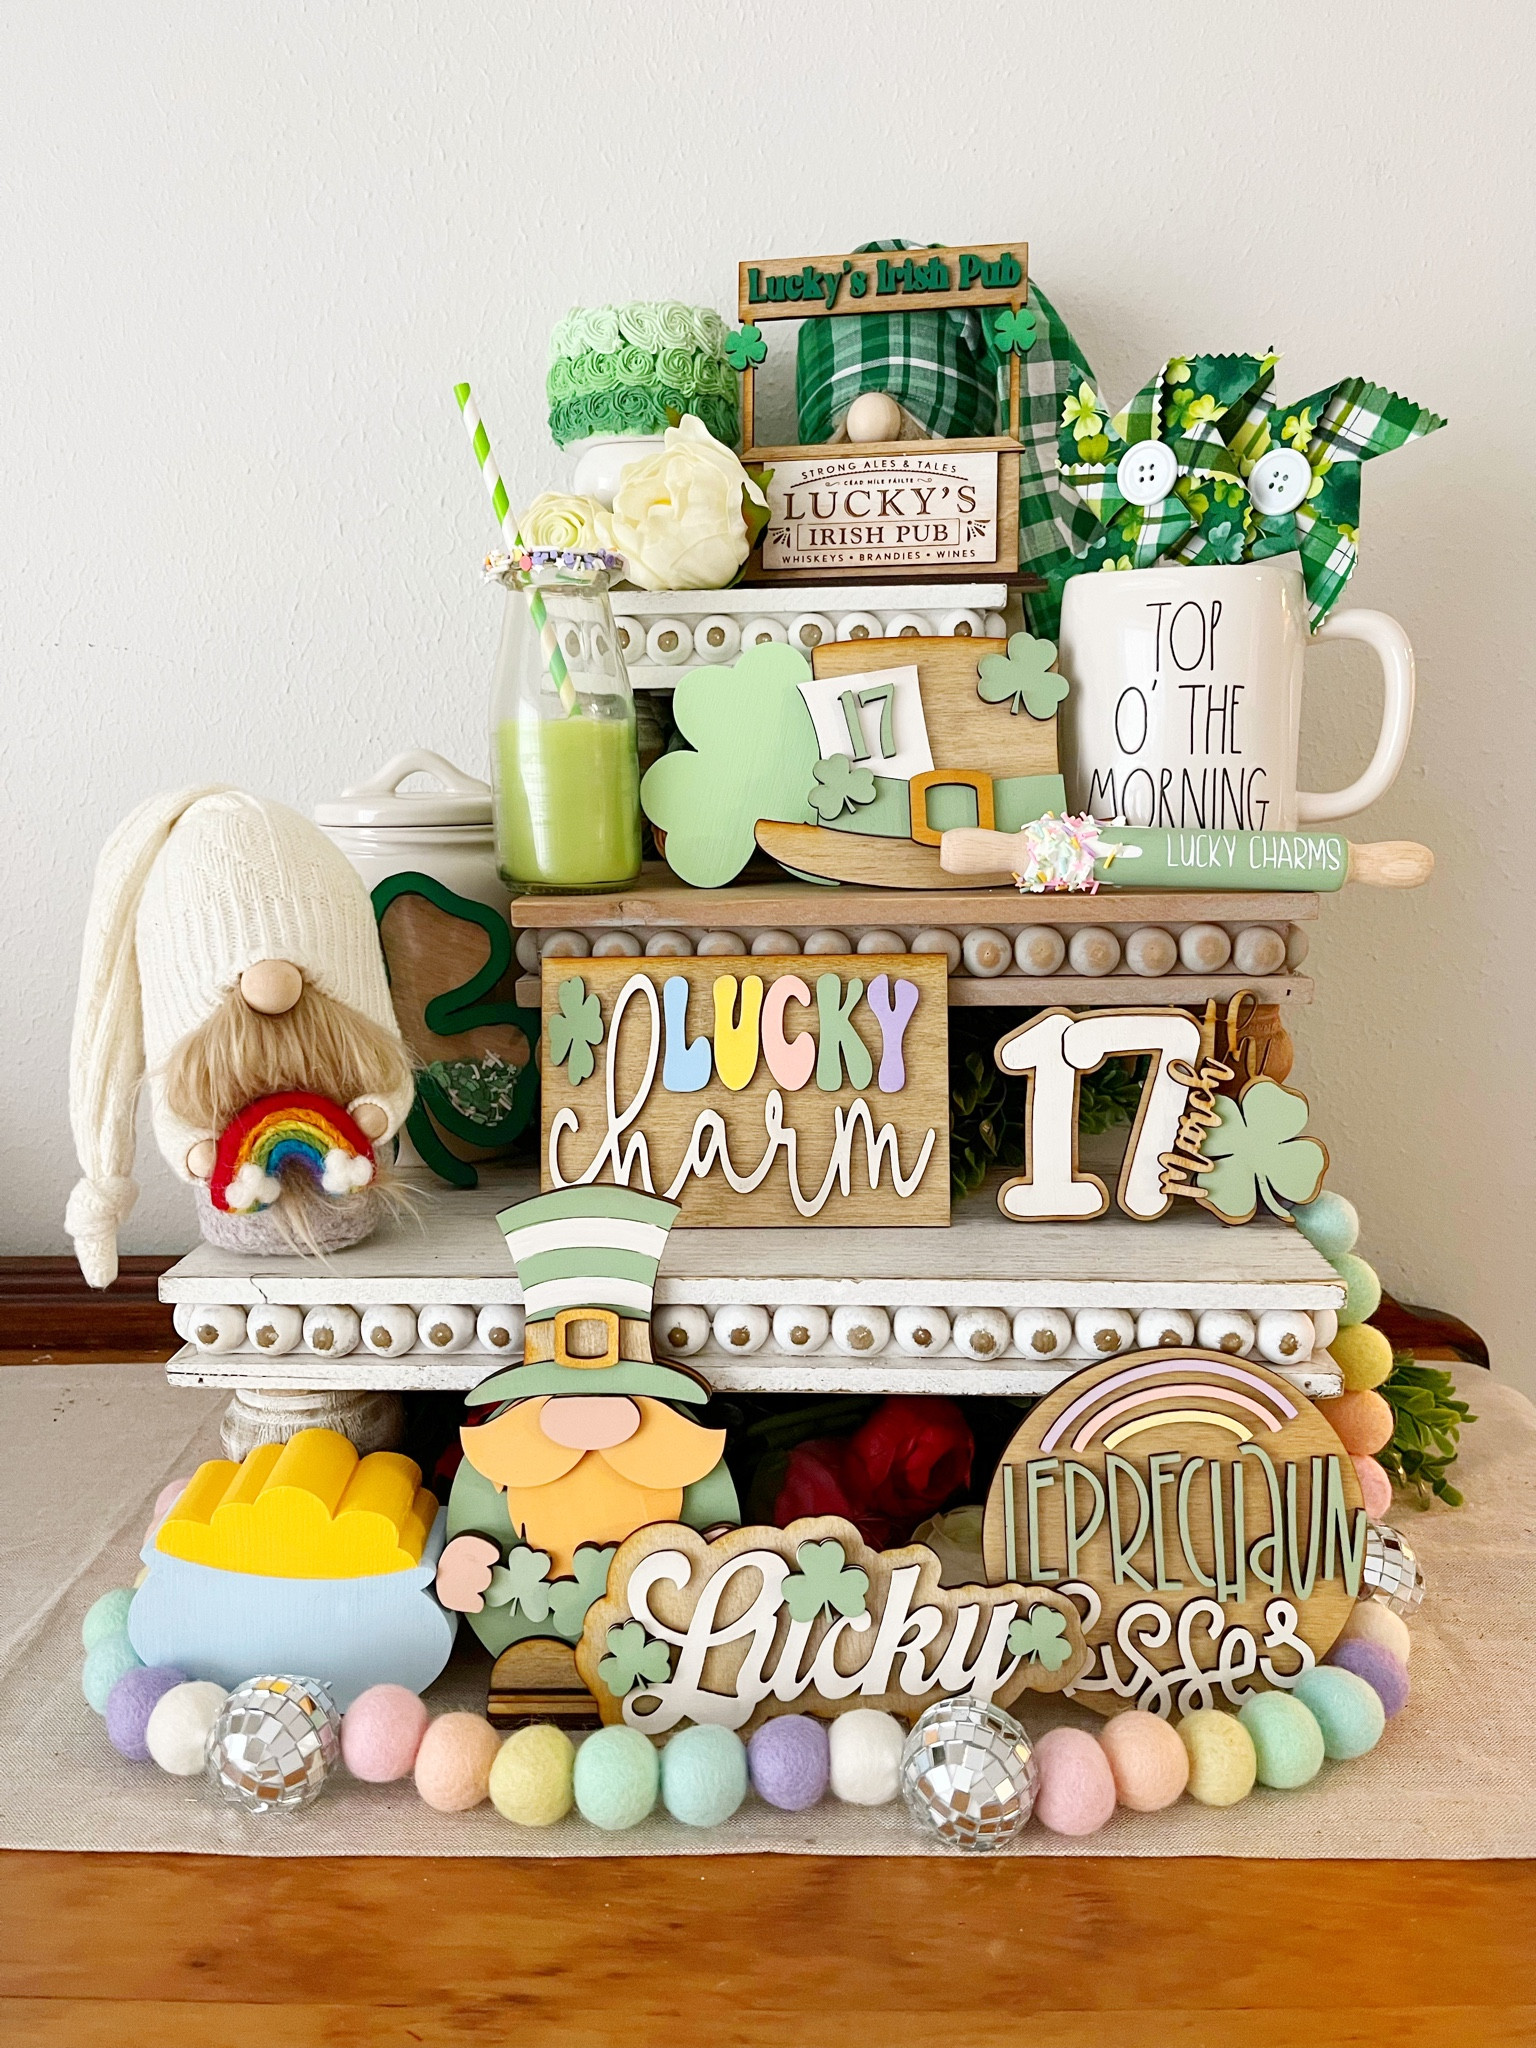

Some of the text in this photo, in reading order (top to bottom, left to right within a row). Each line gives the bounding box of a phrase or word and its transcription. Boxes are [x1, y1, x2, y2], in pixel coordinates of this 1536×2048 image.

[748, 251, 1022, 309] Lucky's Irish Pub
[801, 459, 957, 480] STRONG ALES & TALES
[783, 485, 977, 521] LUCKY'S
[809, 523, 949, 546] IRISH PUB
[782, 548, 977, 564] WHISKEYS BRANDIES WINES
[1146, 600, 1222, 672] TOP
[838, 683, 896, 762] 17
[1115, 679, 1245, 755] O' THE
[1086, 767, 1270, 831] MORNING
[1167, 833, 1341, 871] LUCKY CHARMS
[662, 973, 920, 1093] LUCKY
[548, 973, 937, 1218] charm
[622, 1549, 1020, 1734] Lucky
